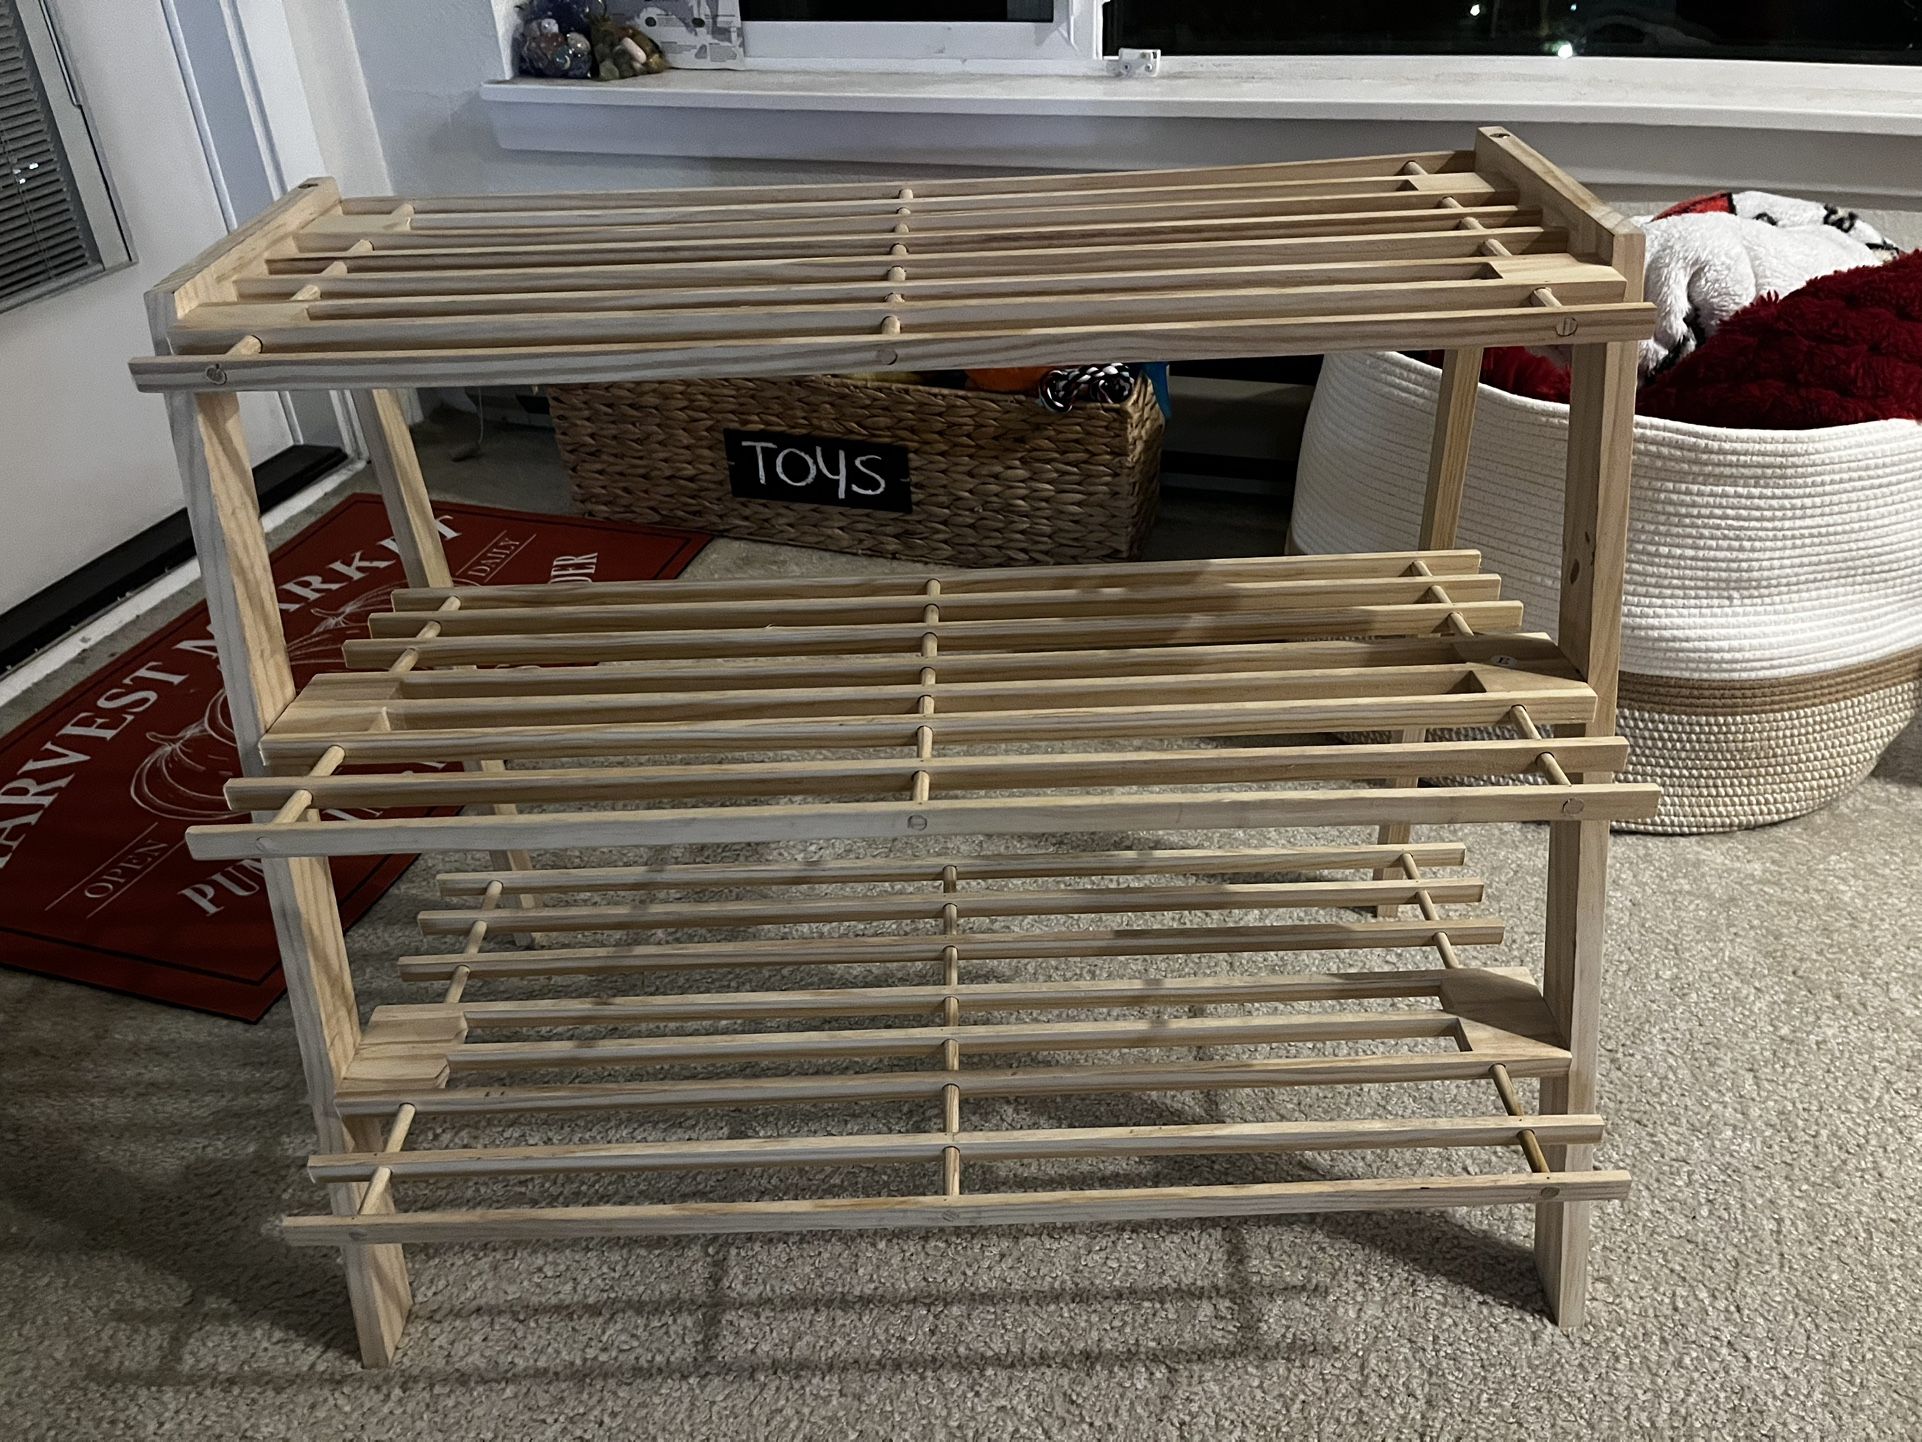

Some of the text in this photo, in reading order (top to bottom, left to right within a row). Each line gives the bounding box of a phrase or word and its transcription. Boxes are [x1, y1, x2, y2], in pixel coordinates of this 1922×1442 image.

[741, 440, 886, 499] TOYS
[0, 661, 189, 869] ARVEST
[84, 838, 169, 899] OPEN
[467, 537, 520, 577] DAILY
